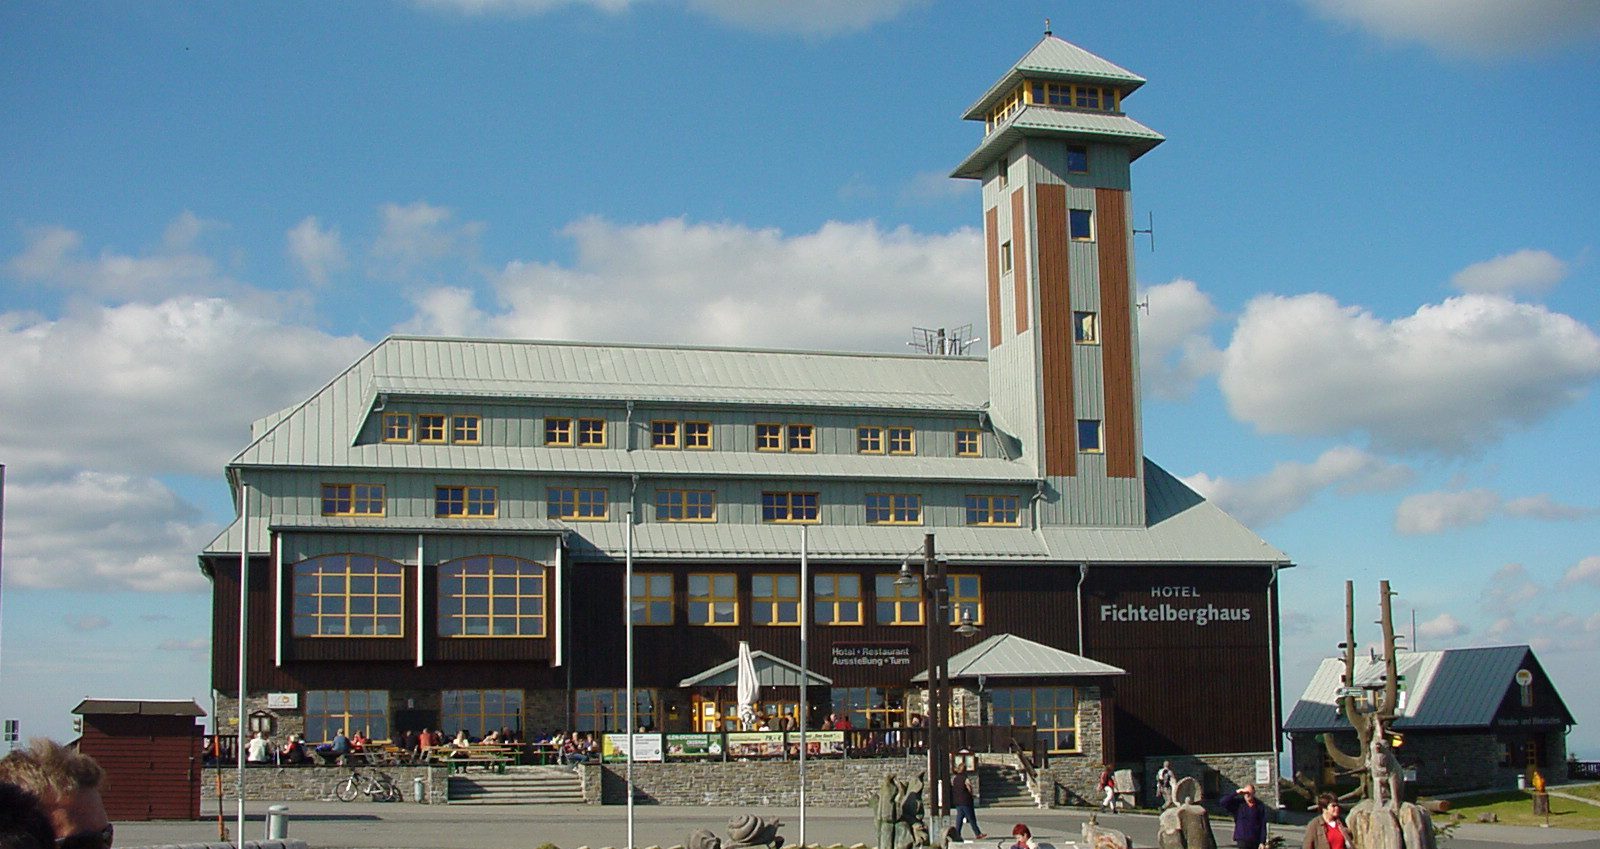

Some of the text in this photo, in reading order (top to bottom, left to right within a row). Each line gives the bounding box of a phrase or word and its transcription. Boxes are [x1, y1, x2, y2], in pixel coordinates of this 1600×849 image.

[1151, 586, 1201, 598] HOTEL
[1100, 603, 1251, 626] Fichtelberghaus
[832, 647, 909, 656] Hotel Restaurant
[832, 656, 910, 667] Ausstellung Turm
